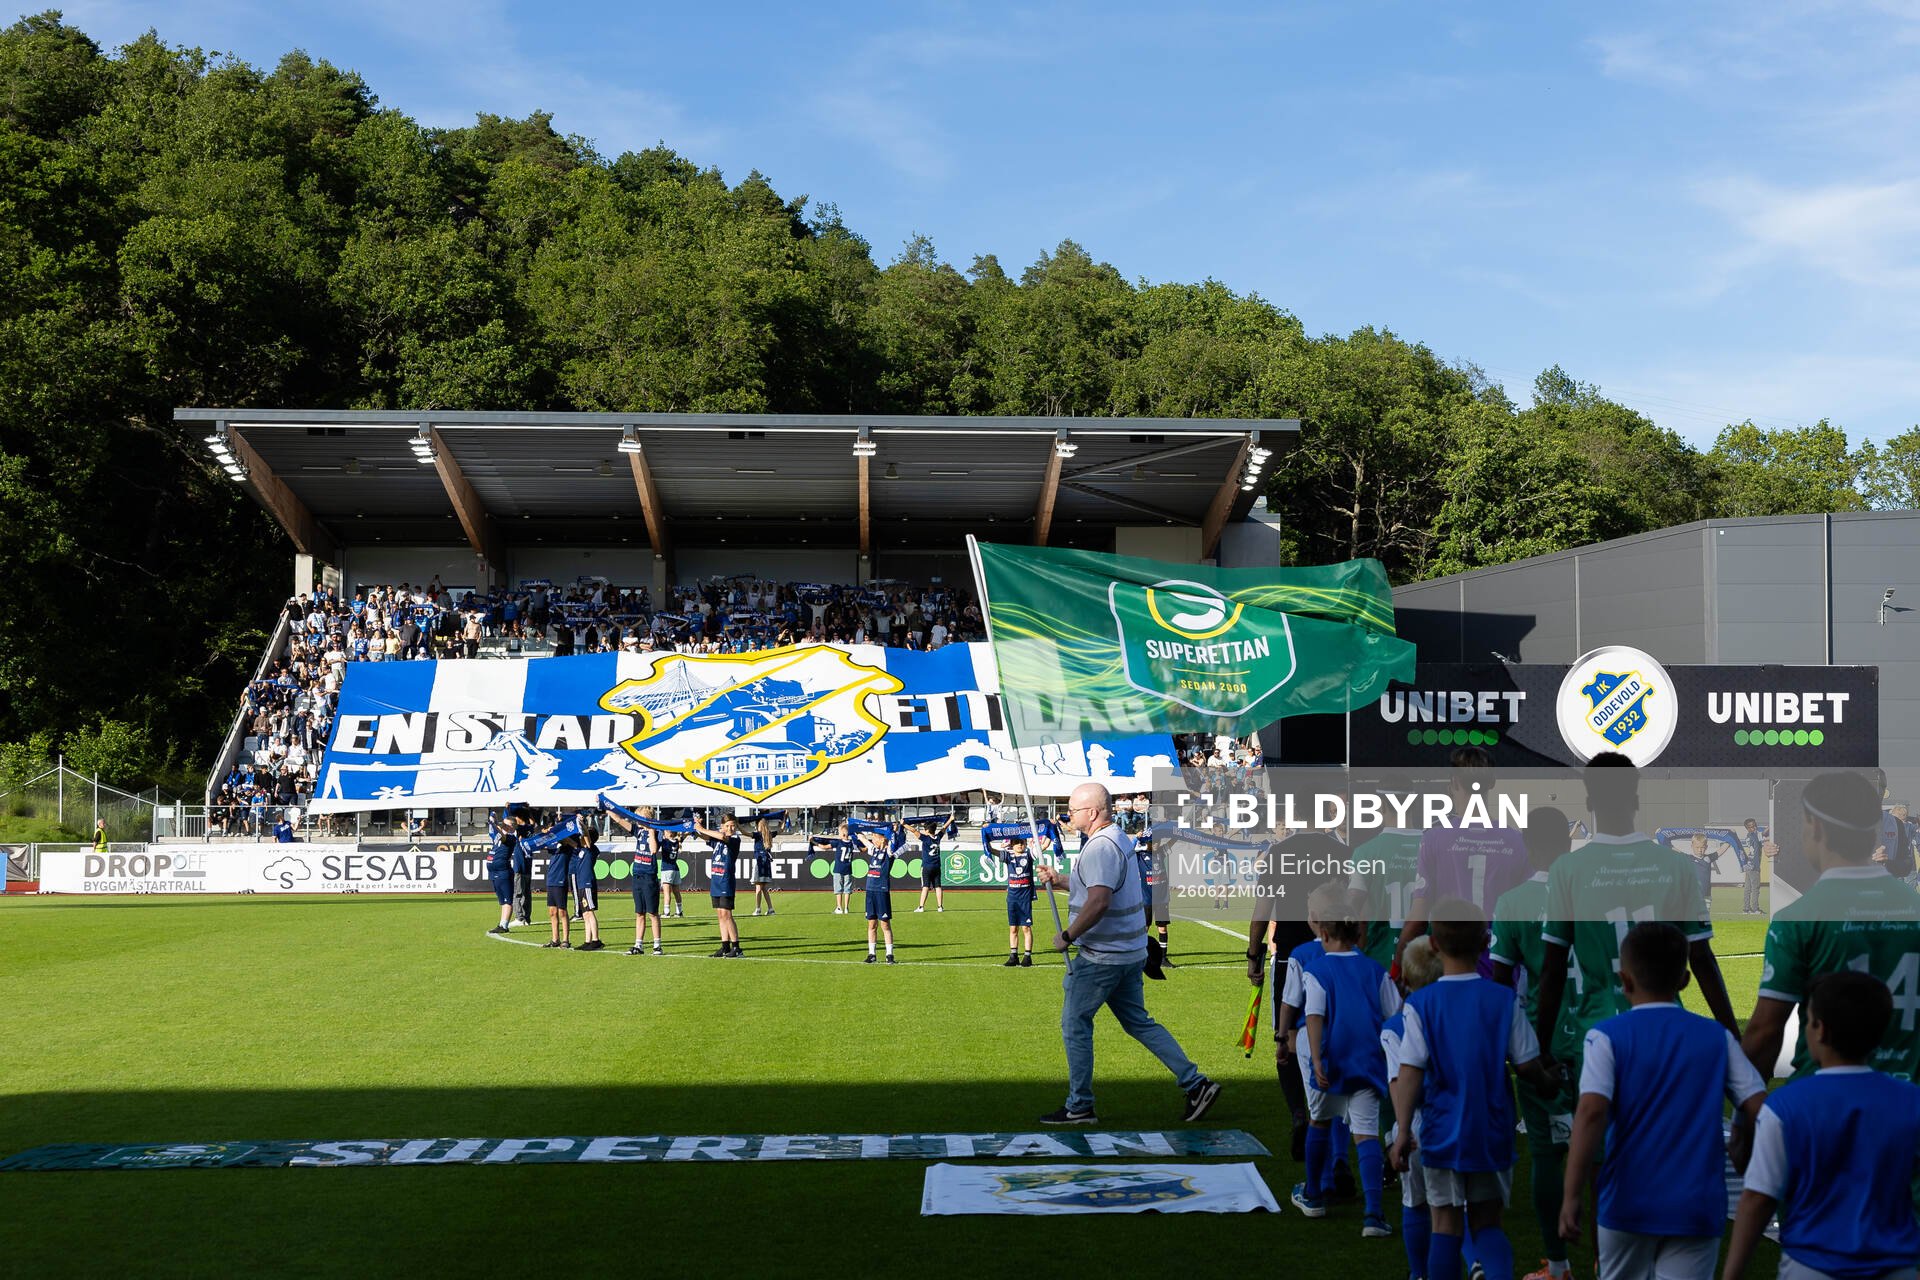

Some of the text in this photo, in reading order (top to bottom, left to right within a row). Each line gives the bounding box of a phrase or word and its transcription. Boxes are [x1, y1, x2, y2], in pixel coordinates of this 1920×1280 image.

[1146, 635, 1270, 664] SUPERETTAN
[1180, 679, 1247, 694] SEDAN 2000
[1596, 680, 1611, 695] IK
[1380, 691, 1526, 723] UNIBET
[1593, 680, 1640, 727] ODDEVOLD
[1708, 692, 1850, 724] UNIBET
[331, 712, 440, 755] EN
[1613, 710, 1640, 736] 1932
[322, 855, 437, 881] SESAB
[289, 1132, 1176, 1167] SUPERETTAN
